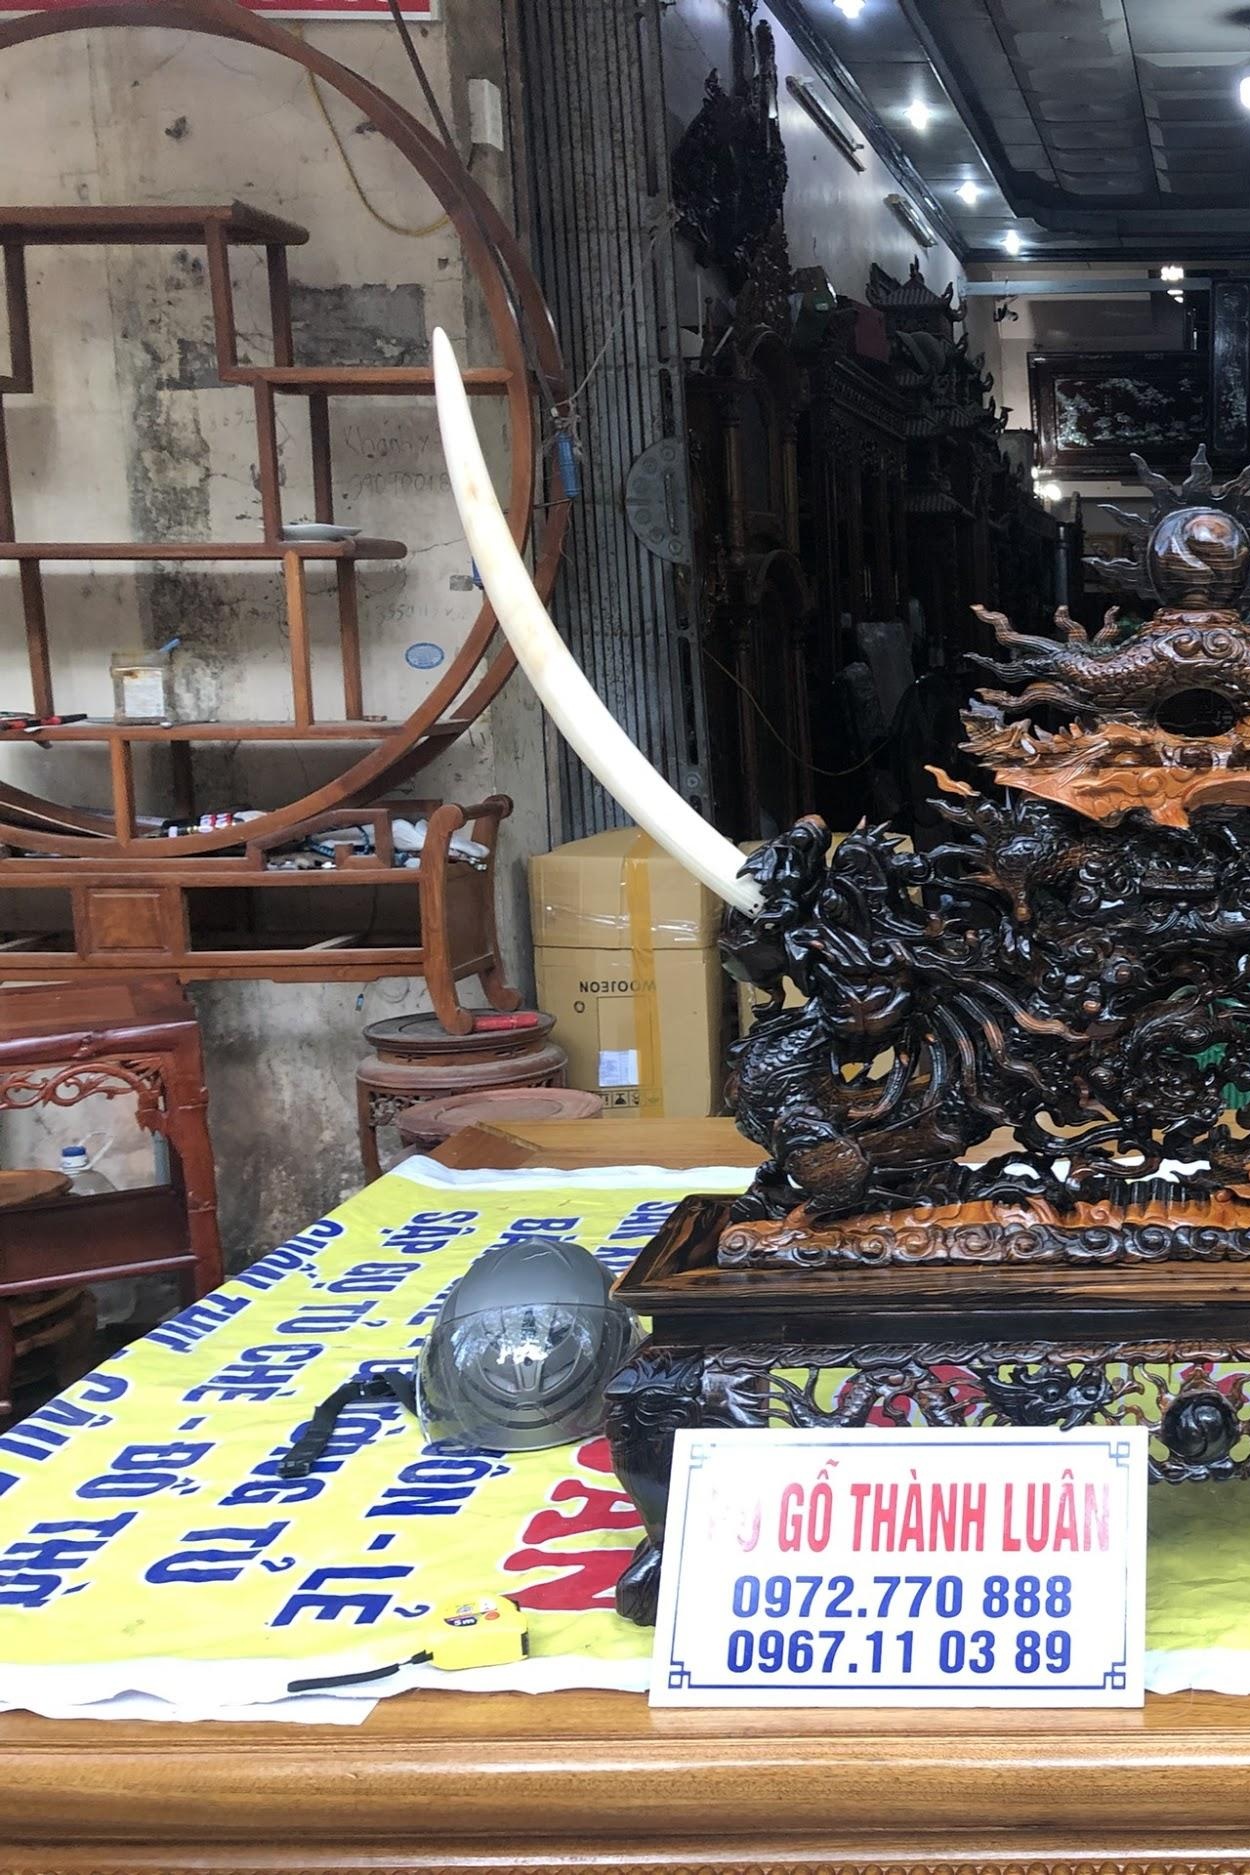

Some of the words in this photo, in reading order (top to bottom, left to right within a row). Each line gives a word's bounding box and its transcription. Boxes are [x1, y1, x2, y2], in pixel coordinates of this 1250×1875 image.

[382, 1210, 479, 1254] SẬP
[313, 1262, 421, 1294] GỤ
[276, 1300, 387, 1334] TỦ
[182, 1343, 325, 1403] CHÈ
[76, 1442, 216, 1498] ĐỒ
[365, 1437, 511, 1518] UÔN
[777, 1459, 839, 1552] GỖ
[850, 1468, 987, 1553] THÀNH
[1001, 1468, 1110, 1553] LUÂN
[0, 1511, 139, 1608] THỜ
[145, 1520, 296, 1584] TỦ
[271, 1566, 430, 1627] LẺ
[732, 1575, 963, 1618] 0972.770
[982, 1575, 1072, 1618] 888
[727, 1629, 913, 1673] 0967.11
[938, 1629, 995, 1673] 03
[1014, 1629, 1072, 1673] 89
